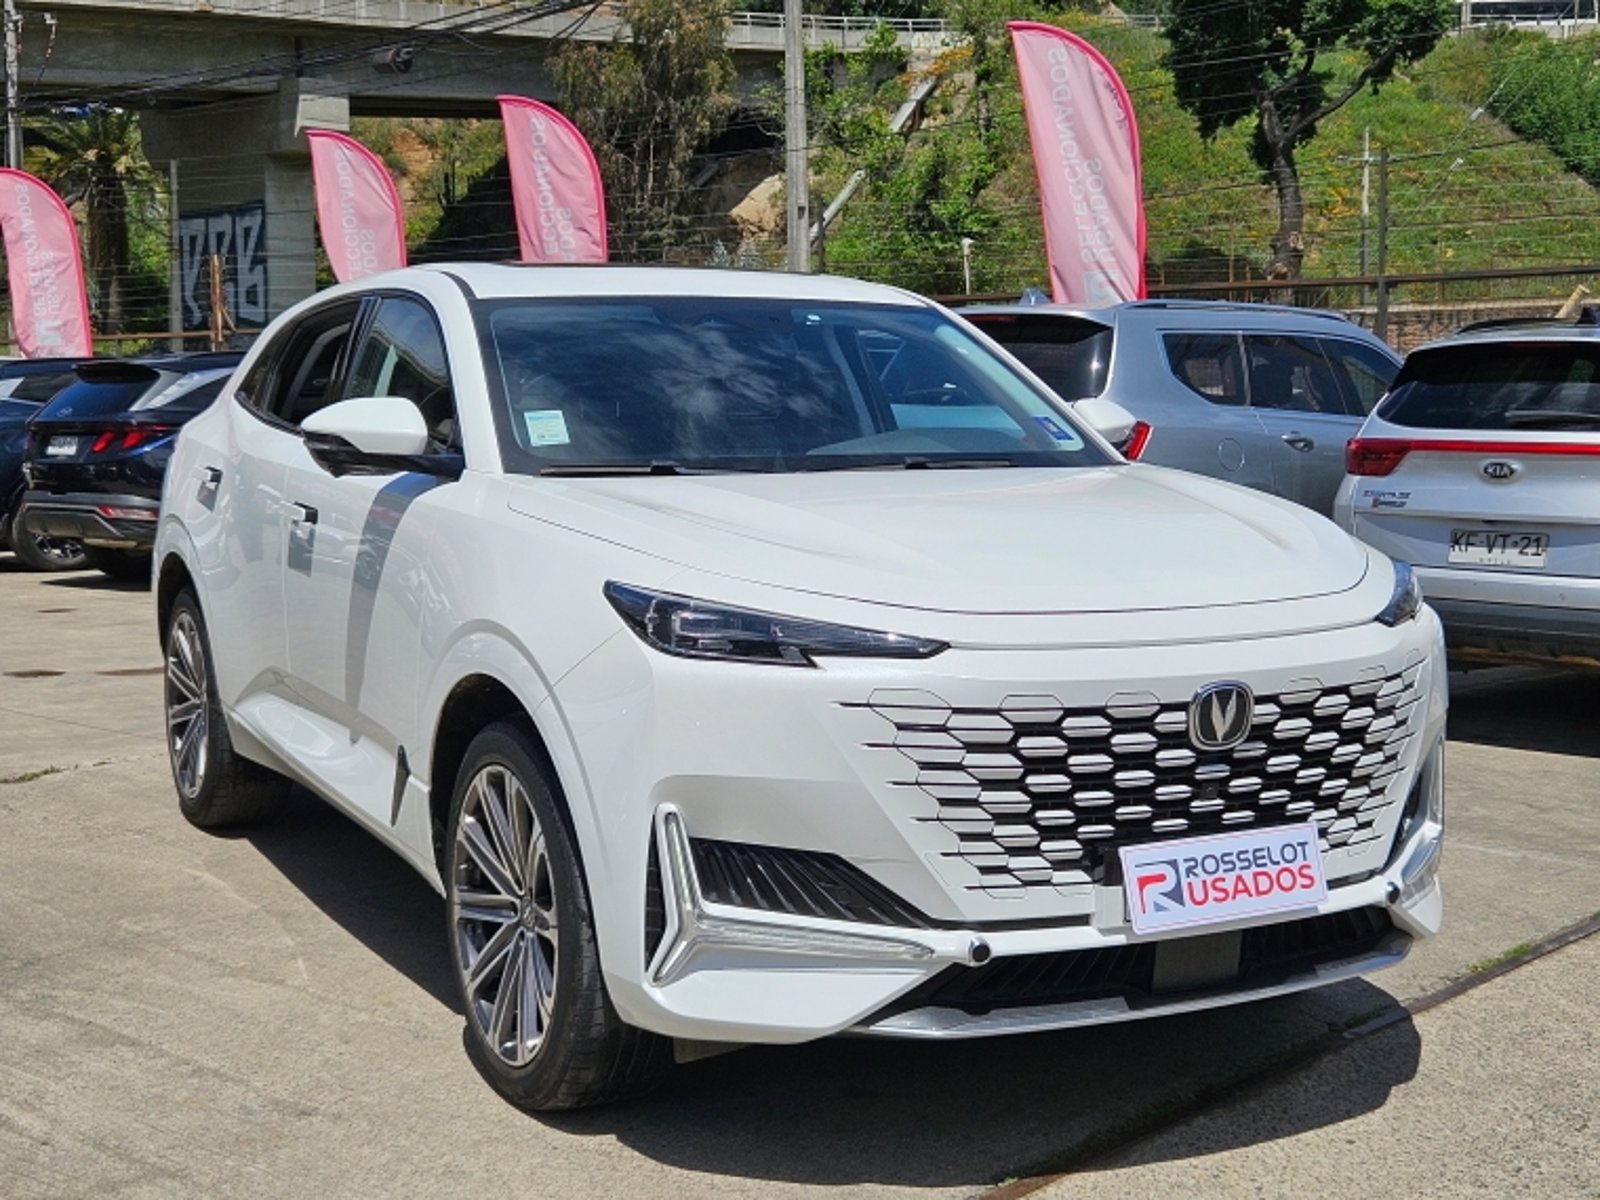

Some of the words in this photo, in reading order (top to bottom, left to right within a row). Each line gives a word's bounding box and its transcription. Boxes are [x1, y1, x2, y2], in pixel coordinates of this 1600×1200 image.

[1486, 462, 1512, 478] KIA
[1183, 841, 1309, 879] ROSSELOT
[1187, 864, 1315, 907] USADOS
